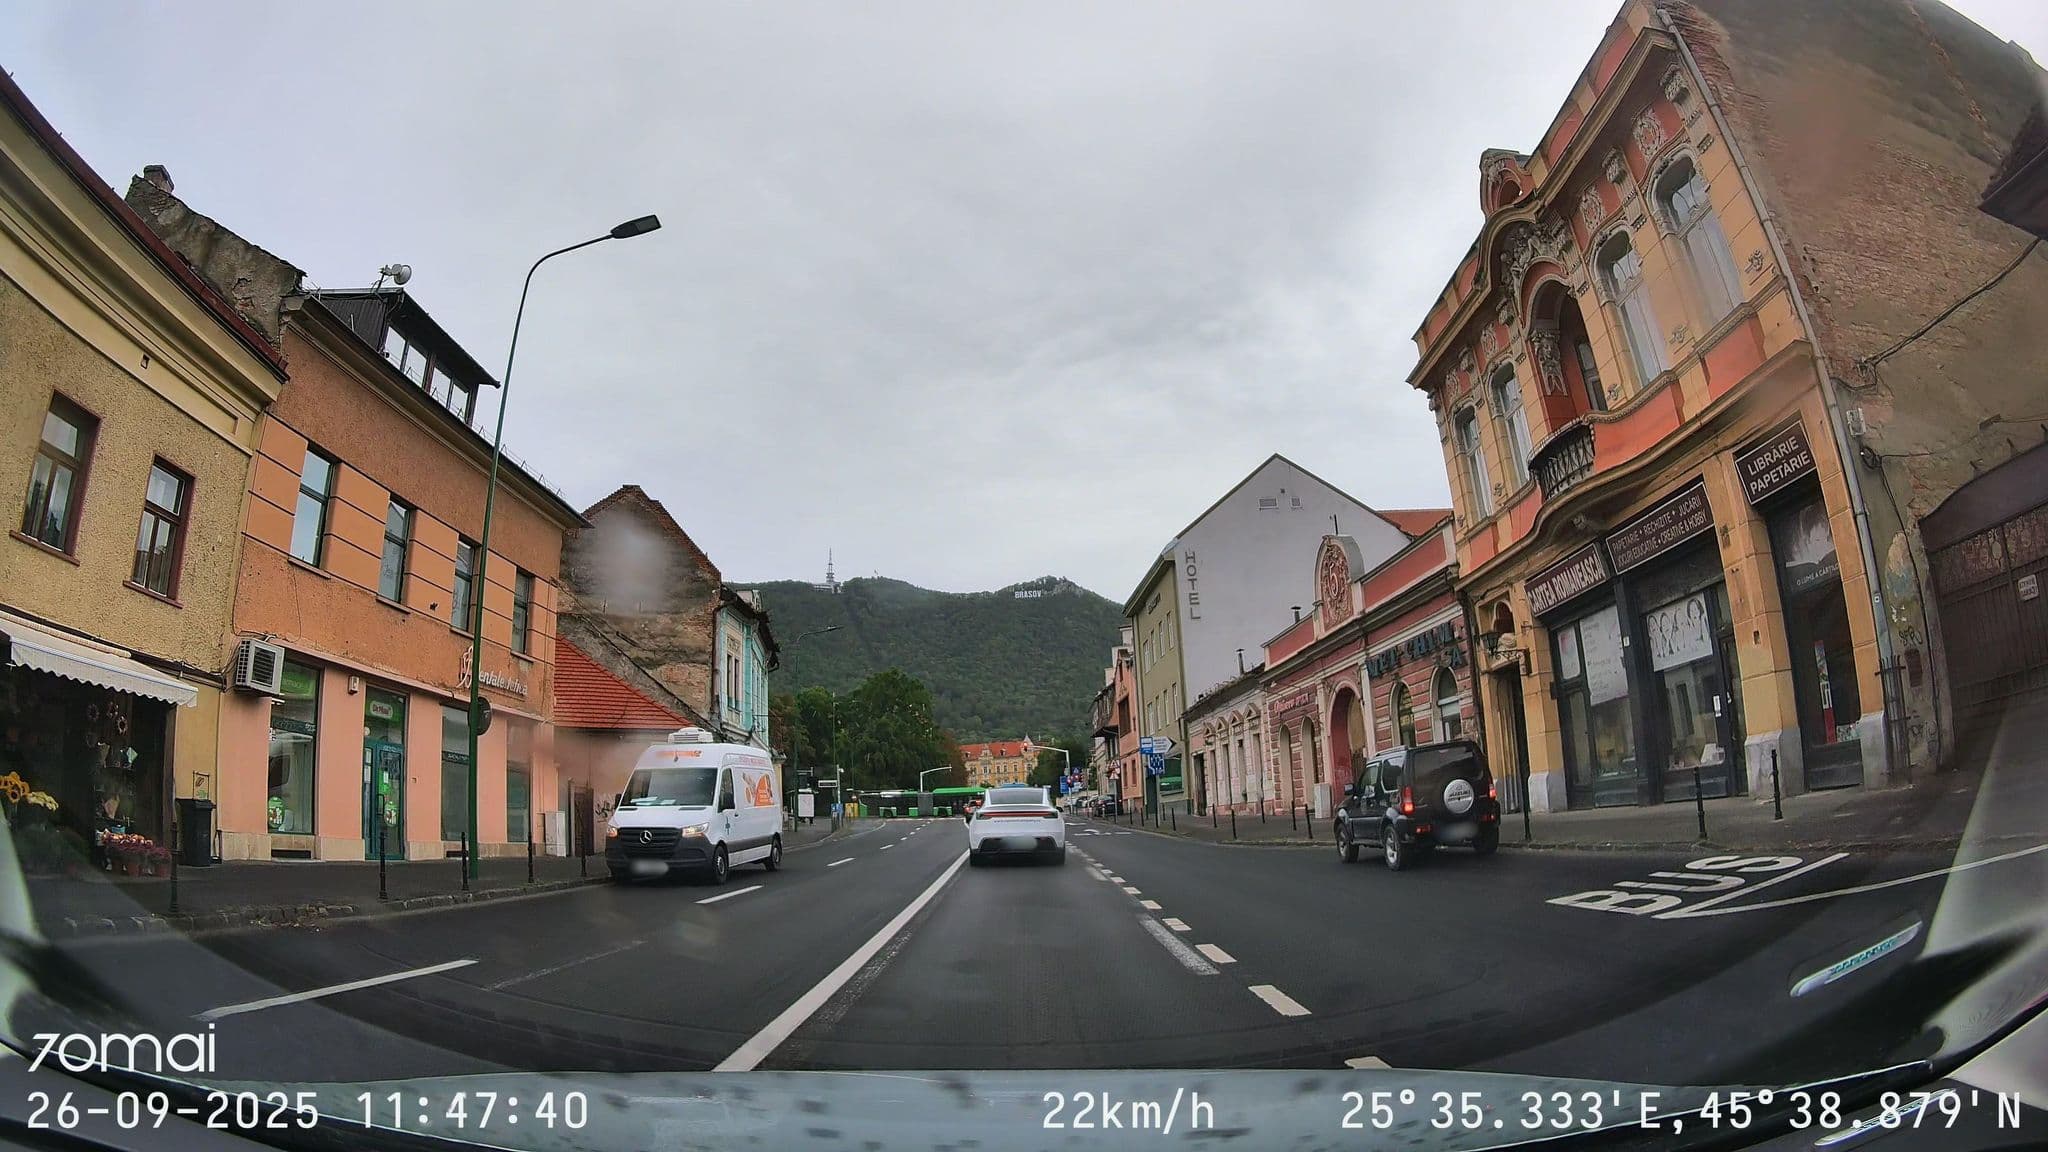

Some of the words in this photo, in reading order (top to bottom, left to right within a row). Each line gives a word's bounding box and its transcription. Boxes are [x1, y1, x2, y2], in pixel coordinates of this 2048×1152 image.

[1747, 436, 1799, 476] LIBRĂRIE
[1749, 451, 1811, 495] PAPETĂRIE
[1687, 509, 1708, 530] HOBBY
[1014, 590, 1042, 599] BRASOV
[1185, 551, 1201, 620] HOTEL
[1527, 580, 1558, 614] CARTEA
[1545, 855, 1803, 916] BUS
